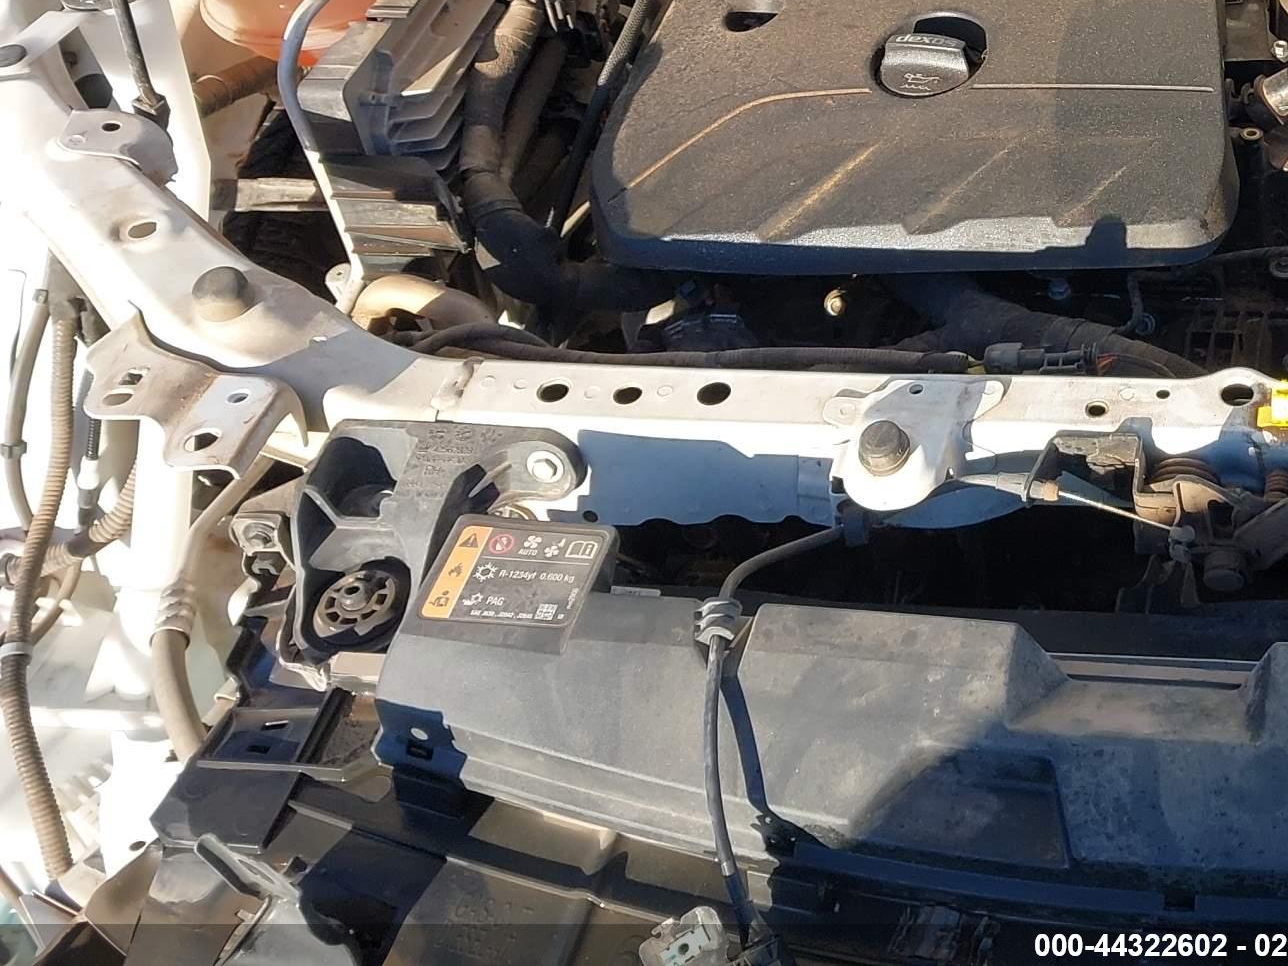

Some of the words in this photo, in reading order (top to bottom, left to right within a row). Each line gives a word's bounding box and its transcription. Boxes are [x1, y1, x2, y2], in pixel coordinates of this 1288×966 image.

[895, 33, 959, 48] dexos
[517, 548, 538, 556] AUTO
[563, 574, 575, 584] kg
[486, 595, 505, 606] PAG
